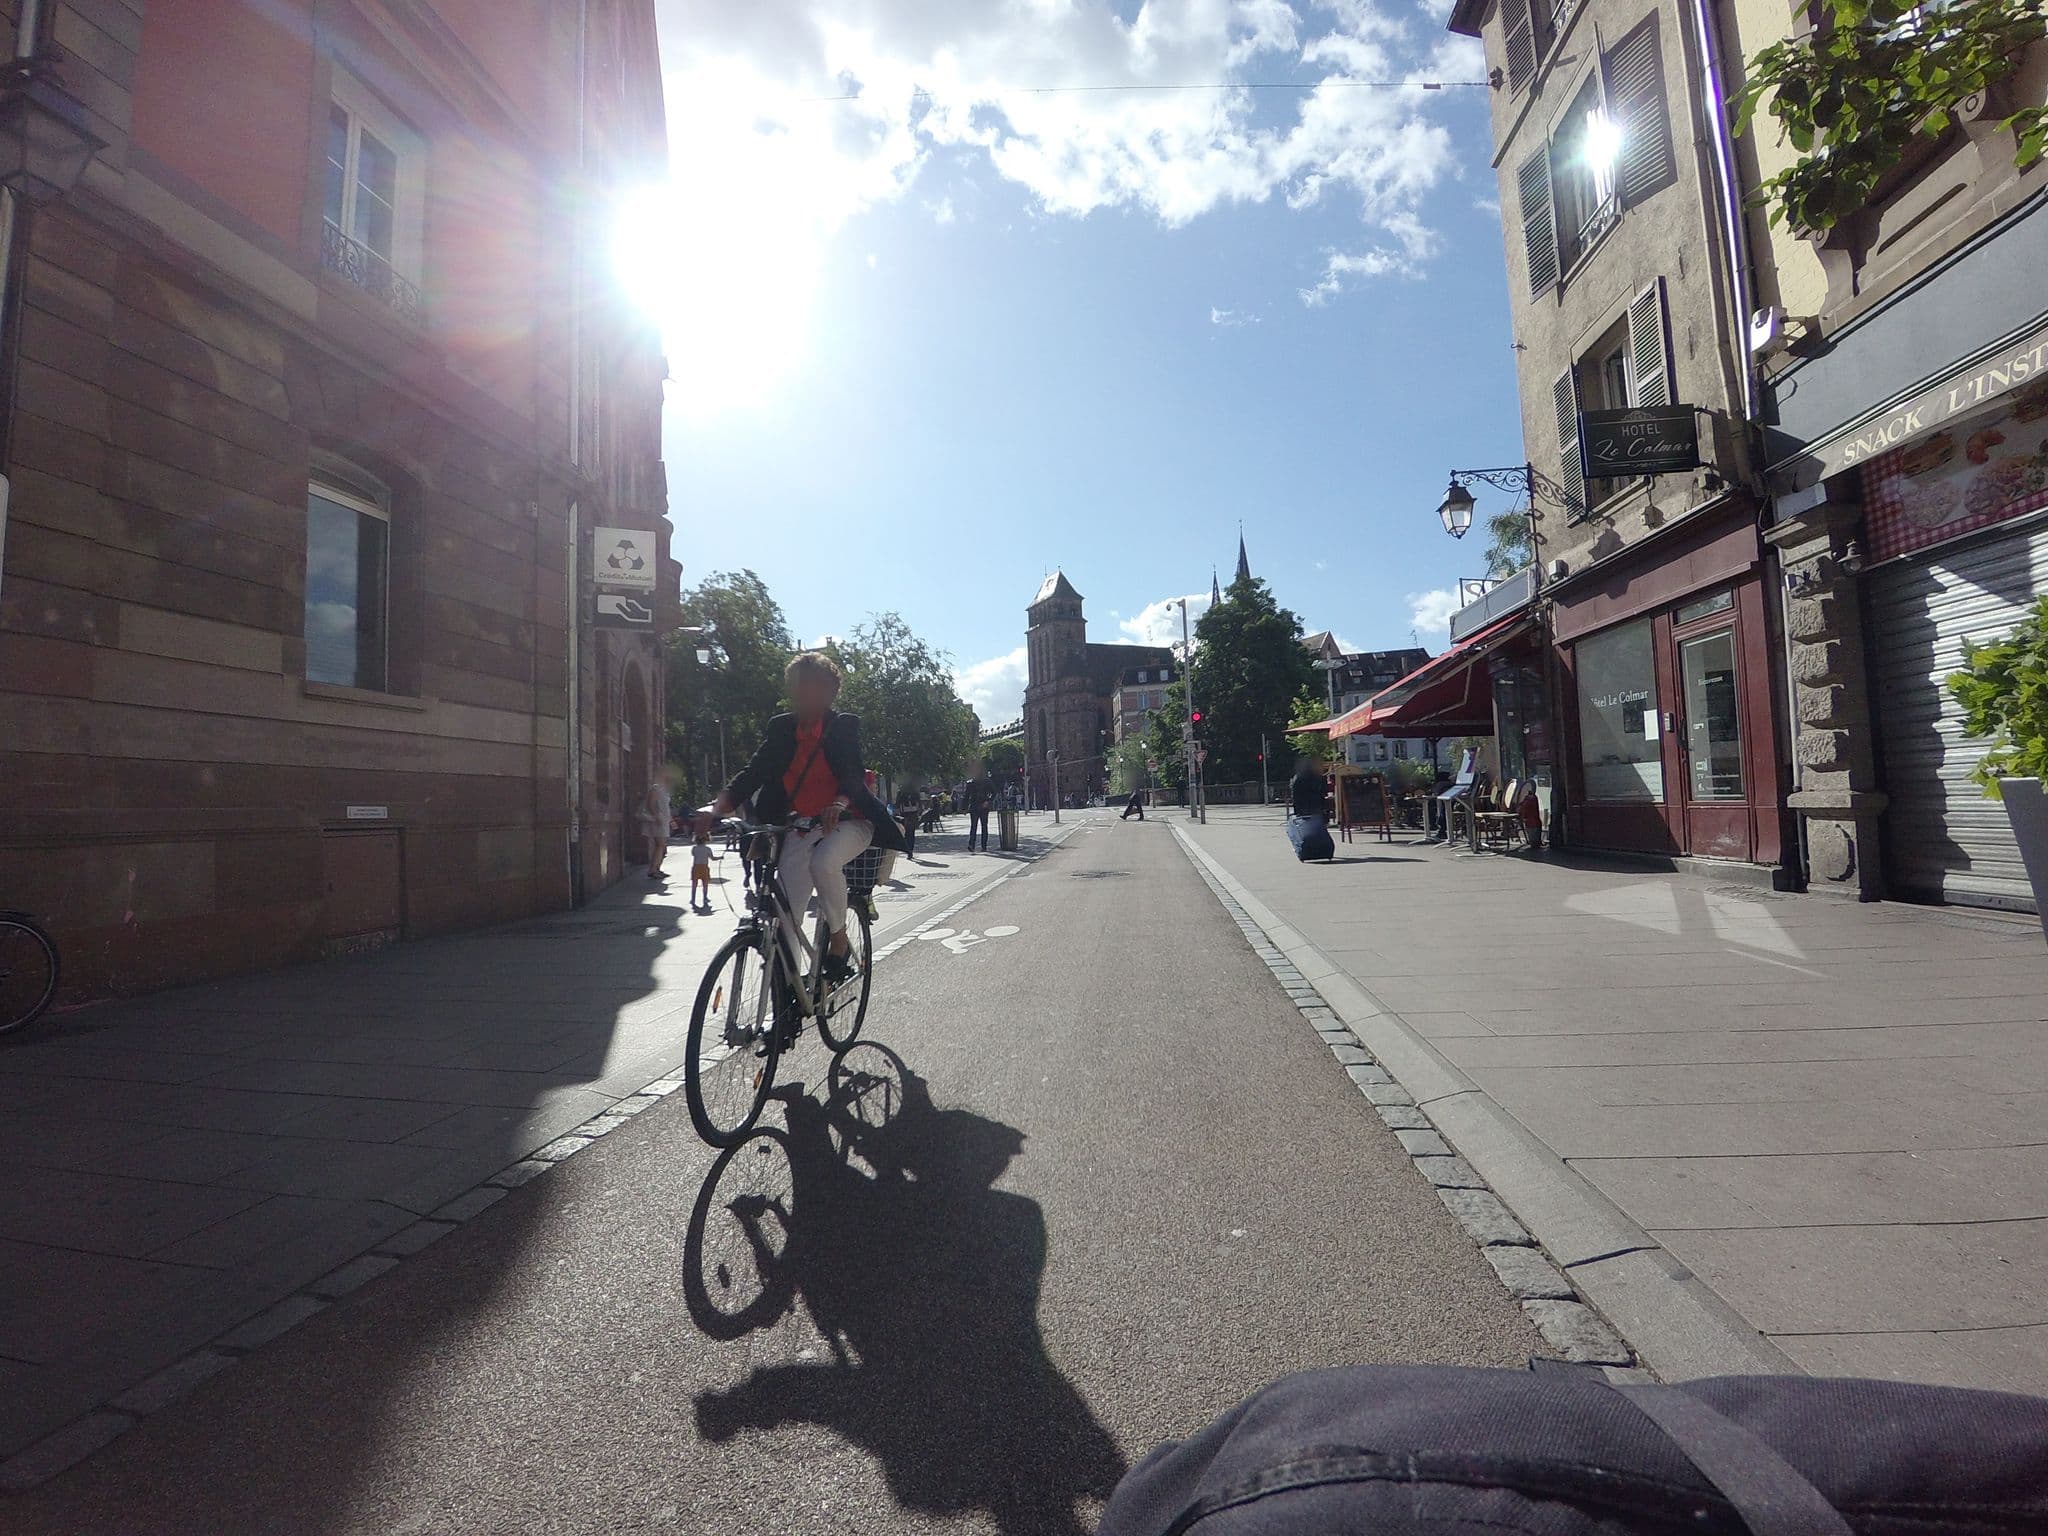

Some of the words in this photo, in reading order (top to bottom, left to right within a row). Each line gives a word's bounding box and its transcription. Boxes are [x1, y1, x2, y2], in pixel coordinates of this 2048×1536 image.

[1621, 423, 1661, 437] HOTEL
[1843, 406, 1925, 465] SNACK
[1593, 439, 1619, 461] Le
[1627, 438, 1692, 458] Colmar
[1619, 690, 1648, 704] Colmar
